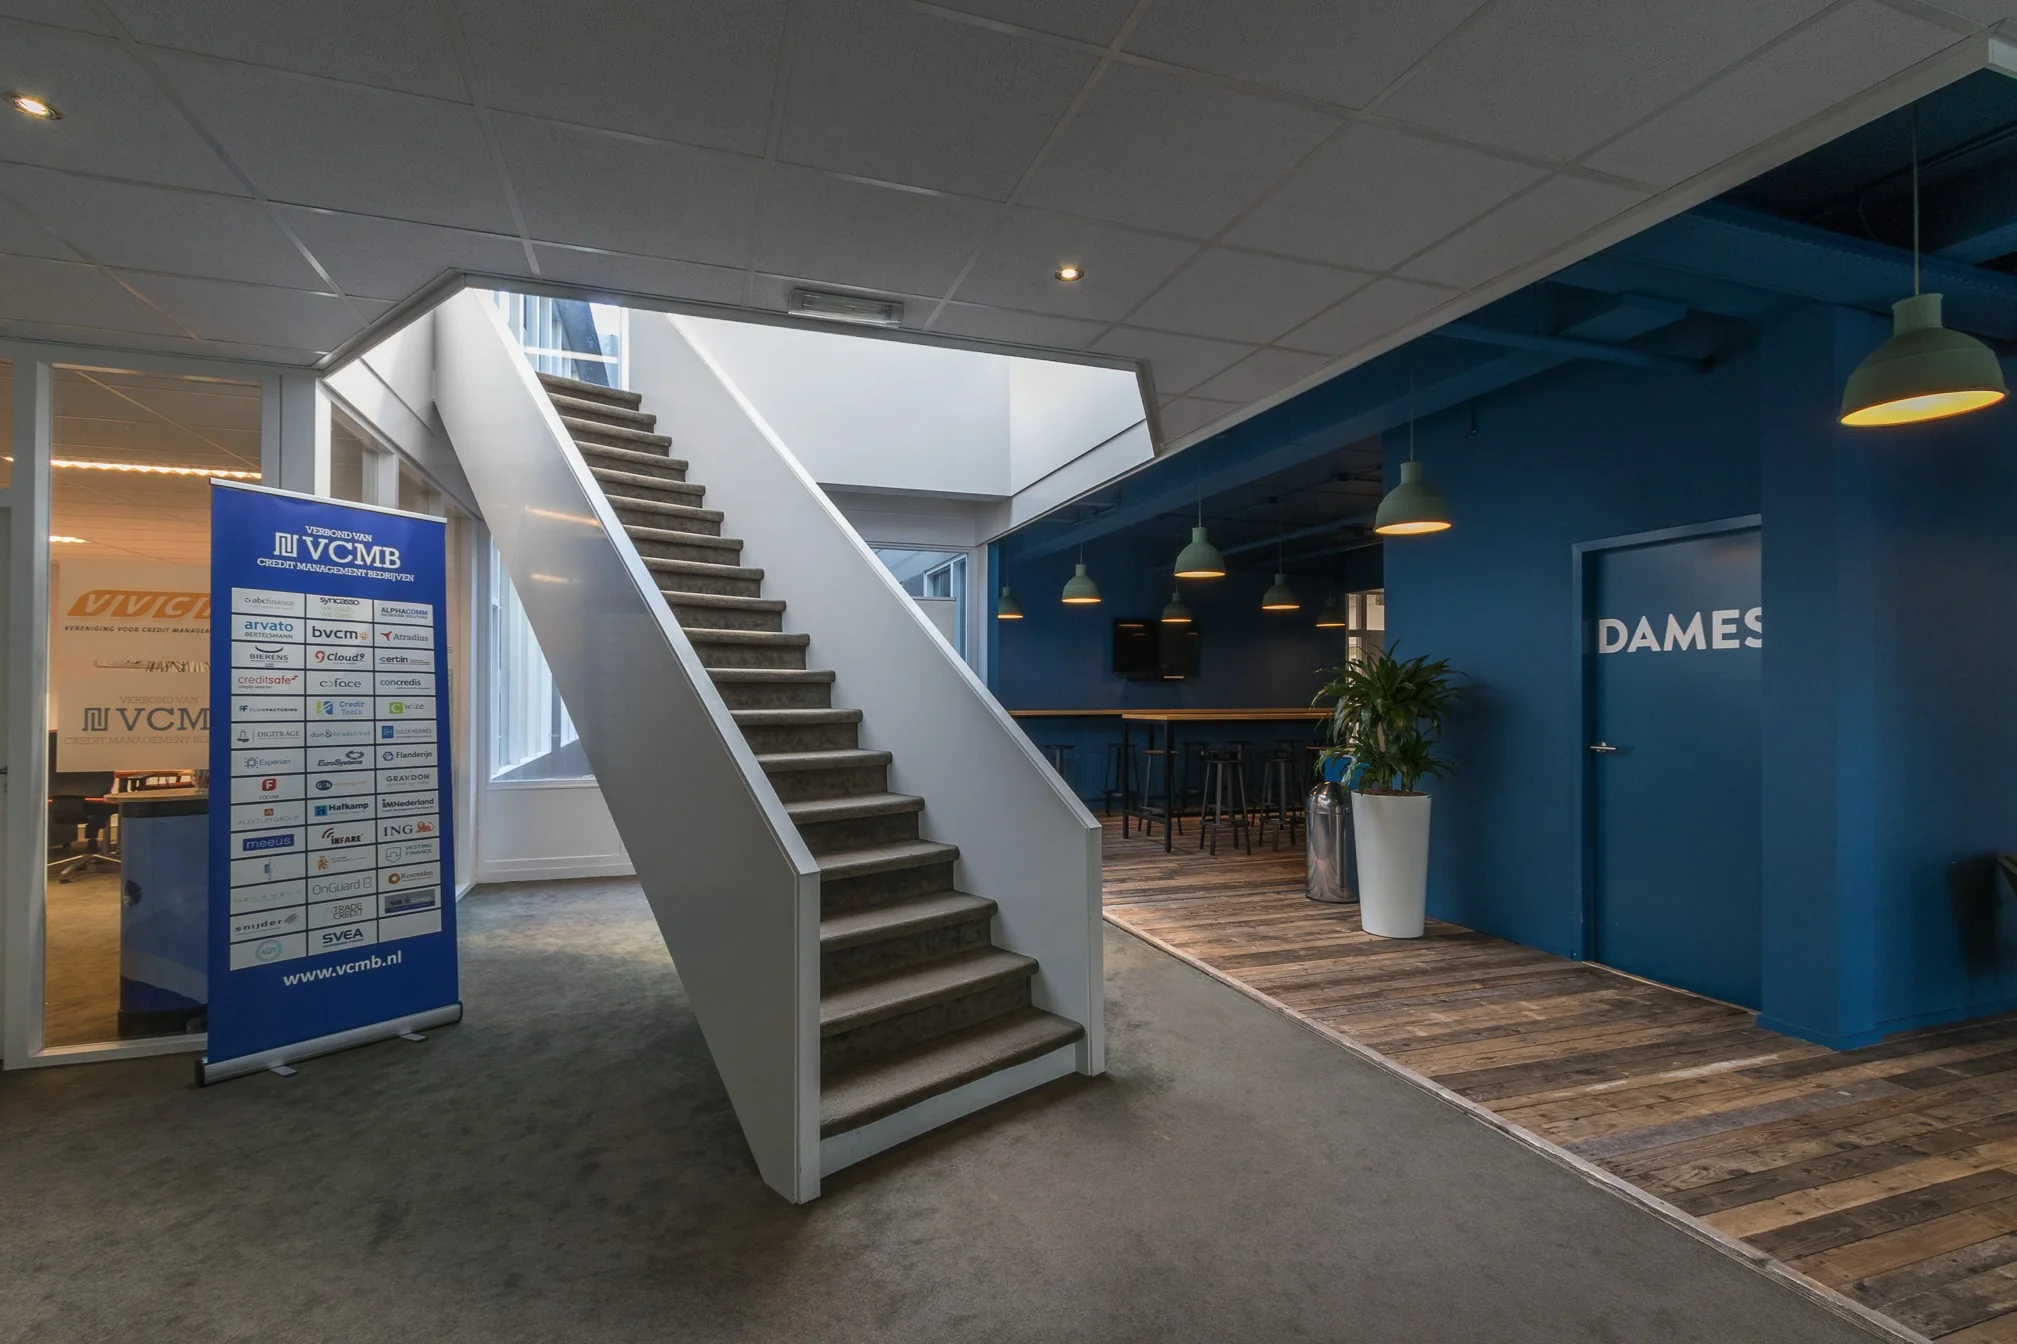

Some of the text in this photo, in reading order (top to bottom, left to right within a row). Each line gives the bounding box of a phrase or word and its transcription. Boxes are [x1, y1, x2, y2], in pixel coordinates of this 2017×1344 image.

[305, 525, 372, 542] VERBOND VAN
[302, 536, 401, 568] VCMB
[257, 558, 415, 582] CREDIT MANAGEMENT BEDRIJVEN
[320, 597, 360, 605] syncasso
[381, 607, 428, 616] ALPHACOMM
[244, 620, 294, 632] arvato
[1599, 606, 1763, 654] DAMES
[244, 631, 294, 640] BERTELSMANN
[312, 625, 358, 640] bvcm
[393, 633, 429, 642] Atradius
[379, 655, 408, 663] certin
[238, 675, 291, 685] creditsafe
[320, 678, 362, 688] coface
[380, 679, 421, 687] concredis
[119, 696, 199, 704] VERBOND VAN
[63, 736, 107, 745] CREDIT
[108, 735, 191, 745] MANAGEMENT
[396, 751, 432, 759] Flanderijn
[259, 757, 291, 767] Experian
[386, 773, 430, 782] GRAYDON
[329, 802, 369, 811] Hafkamp
[383, 825, 413, 837] ING
[245, 836, 291, 849] meeus
[312, 880, 360, 895] OnGuard
[235, 919, 282, 931] snijder
[322, 928, 364, 944] SVEA
[283, 950, 402, 986] www.vcmb.nl
